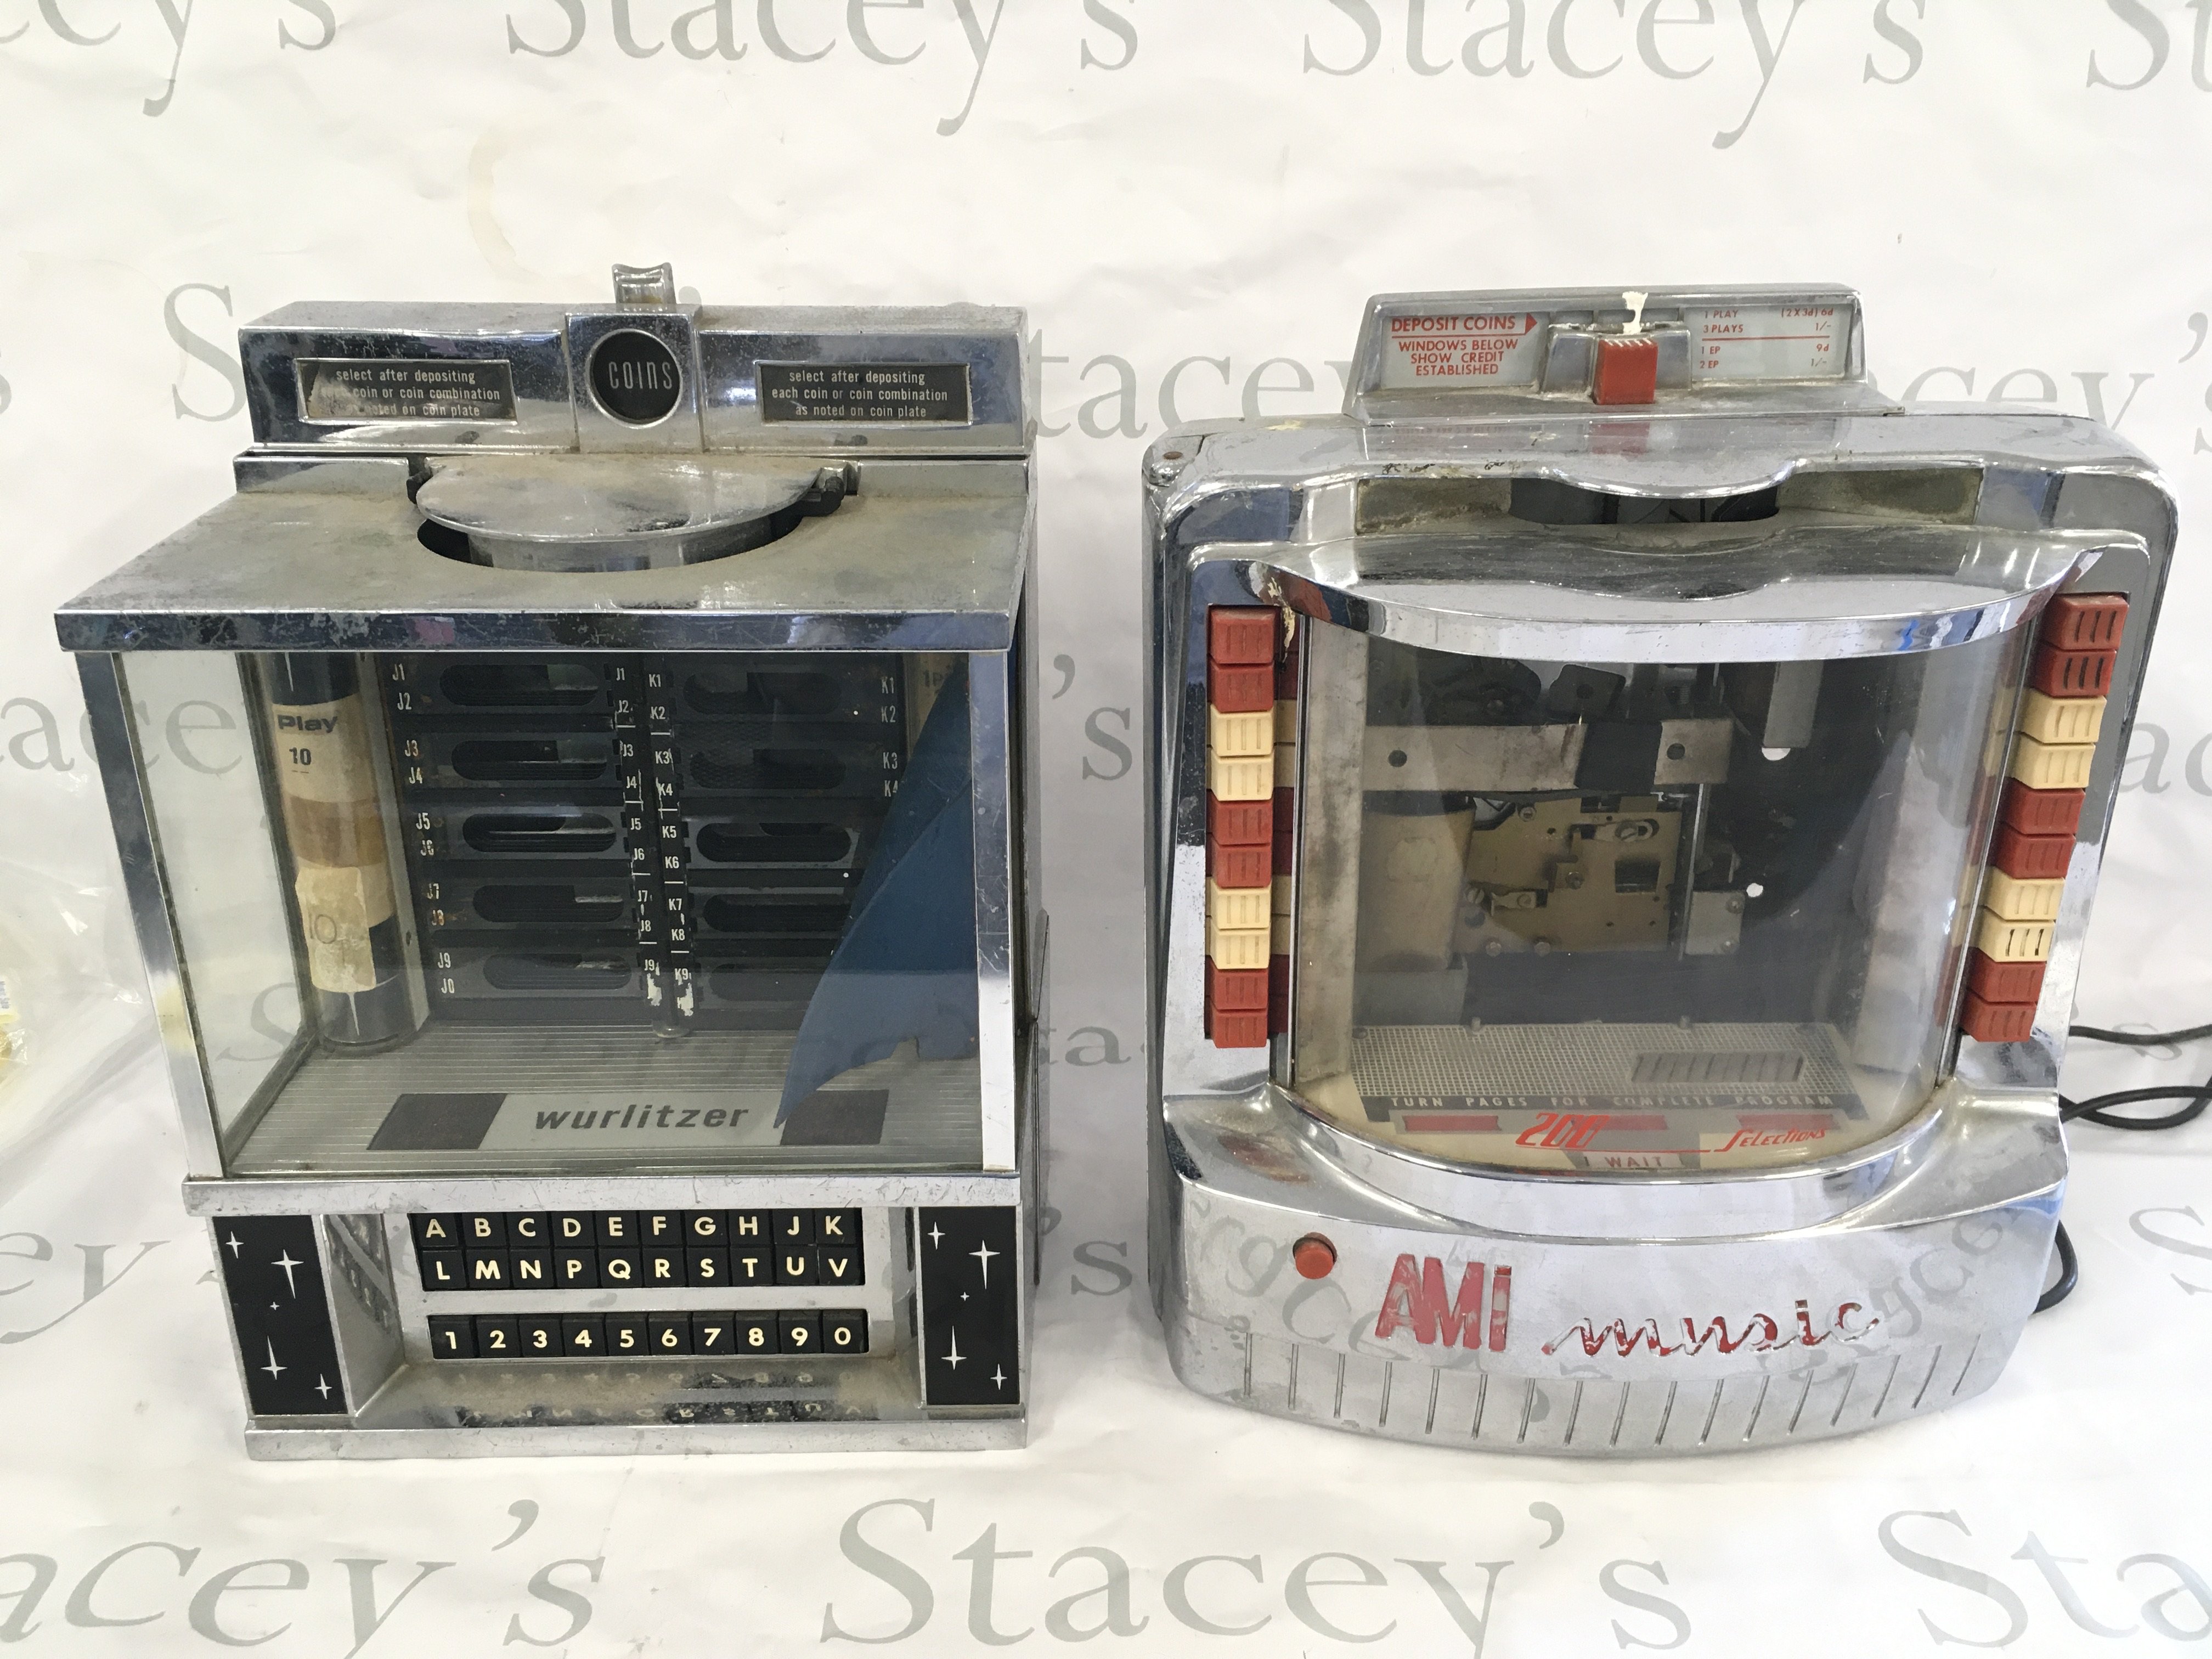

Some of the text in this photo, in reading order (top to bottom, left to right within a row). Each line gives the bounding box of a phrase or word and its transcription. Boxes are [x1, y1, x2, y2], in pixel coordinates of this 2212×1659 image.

[1713, 309, 1739, 318] PLAY
[1391, 315, 1515, 332] DEPOSIT COINS
[1703, 325, 1709, 334] 3
[1712, 324, 1743, 334] PLAYS
[1399, 338, 1518, 352] WINDOWS BELOW
[1709, 346, 1720, 354] EP
[1411, 351, 1504, 364] SHOW CREDIT
[336, 368, 476, 384] select after depositing
[1416, 364, 1498, 376] ESTABLISHED
[789, 370, 926, 385] select after depositing
[354, 386, 378, 398] coin
[382, 388, 393, 398] or
[400, 387, 424, 399] coin
[430, 387, 500, 400] combination
[772, 387, 948, 401] each coin or coin combination
[402, 404, 416, 415] on
[422, 404, 445, 416] coin
[451, 404, 481, 417] plate
[795, 405, 927, 419] as noted on coin plate
[392, 664, 405, 681] J1
[616, 668, 625, 681] J1
[649, 674, 661, 687] K1
[397, 693, 412, 710] J2
[618, 700, 629, 713] J2
[650, 707, 665, 720] K2
[881, 705, 896, 723] K2
[277, 714, 338, 733] Play
[404, 740, 419, 757] J3
[622, 744, 634, 757] J3
[289, 747, 312, 765] 10
[655, 751, 670, 764] K3
[883, 752, 898, 769] K3
[409, 767, 422, 784] J4
[626, 776, 637, 789] J4
[658, 783, 673, 797] K4
[416, 812, 430, 830] J5
[630, 818, 641, 831] J5
[662, 826, 676, 839] K5
[633, 848, 645, 861] J6
[665, 856, 679, 869] K6
[637, 890, 648, 902] J7
[668, 898, 682, 911] K7
[640, 920, 652, 932] J8
[671, 929, 685, 941] K8
[438, 953, 451, 969] J9
[644, 959, 655, 971] J9
[674, 968, 689, 980] K9
[1391, 1097, 1443, 1107] TURN
[1465, 1097, 1528, 1107] PAGES
[1551, 1097, 1589, 1107] FOR
[534, 1103, 749, 1130] wurlitzer
[1515, 1112, 1610, 1149] 200
[1604, 1156, 1662, 1167] WAIT
[426, 1216, 843, 1238] A B C D E F G H J K
[436, 1256, 848, 1280] L M N P Q R S T U V
[445, 1327, 851, 1350] 1 2 3 4 5 6 7 8 9 0
[819, 1498, 1692, 1659] Stacey's
